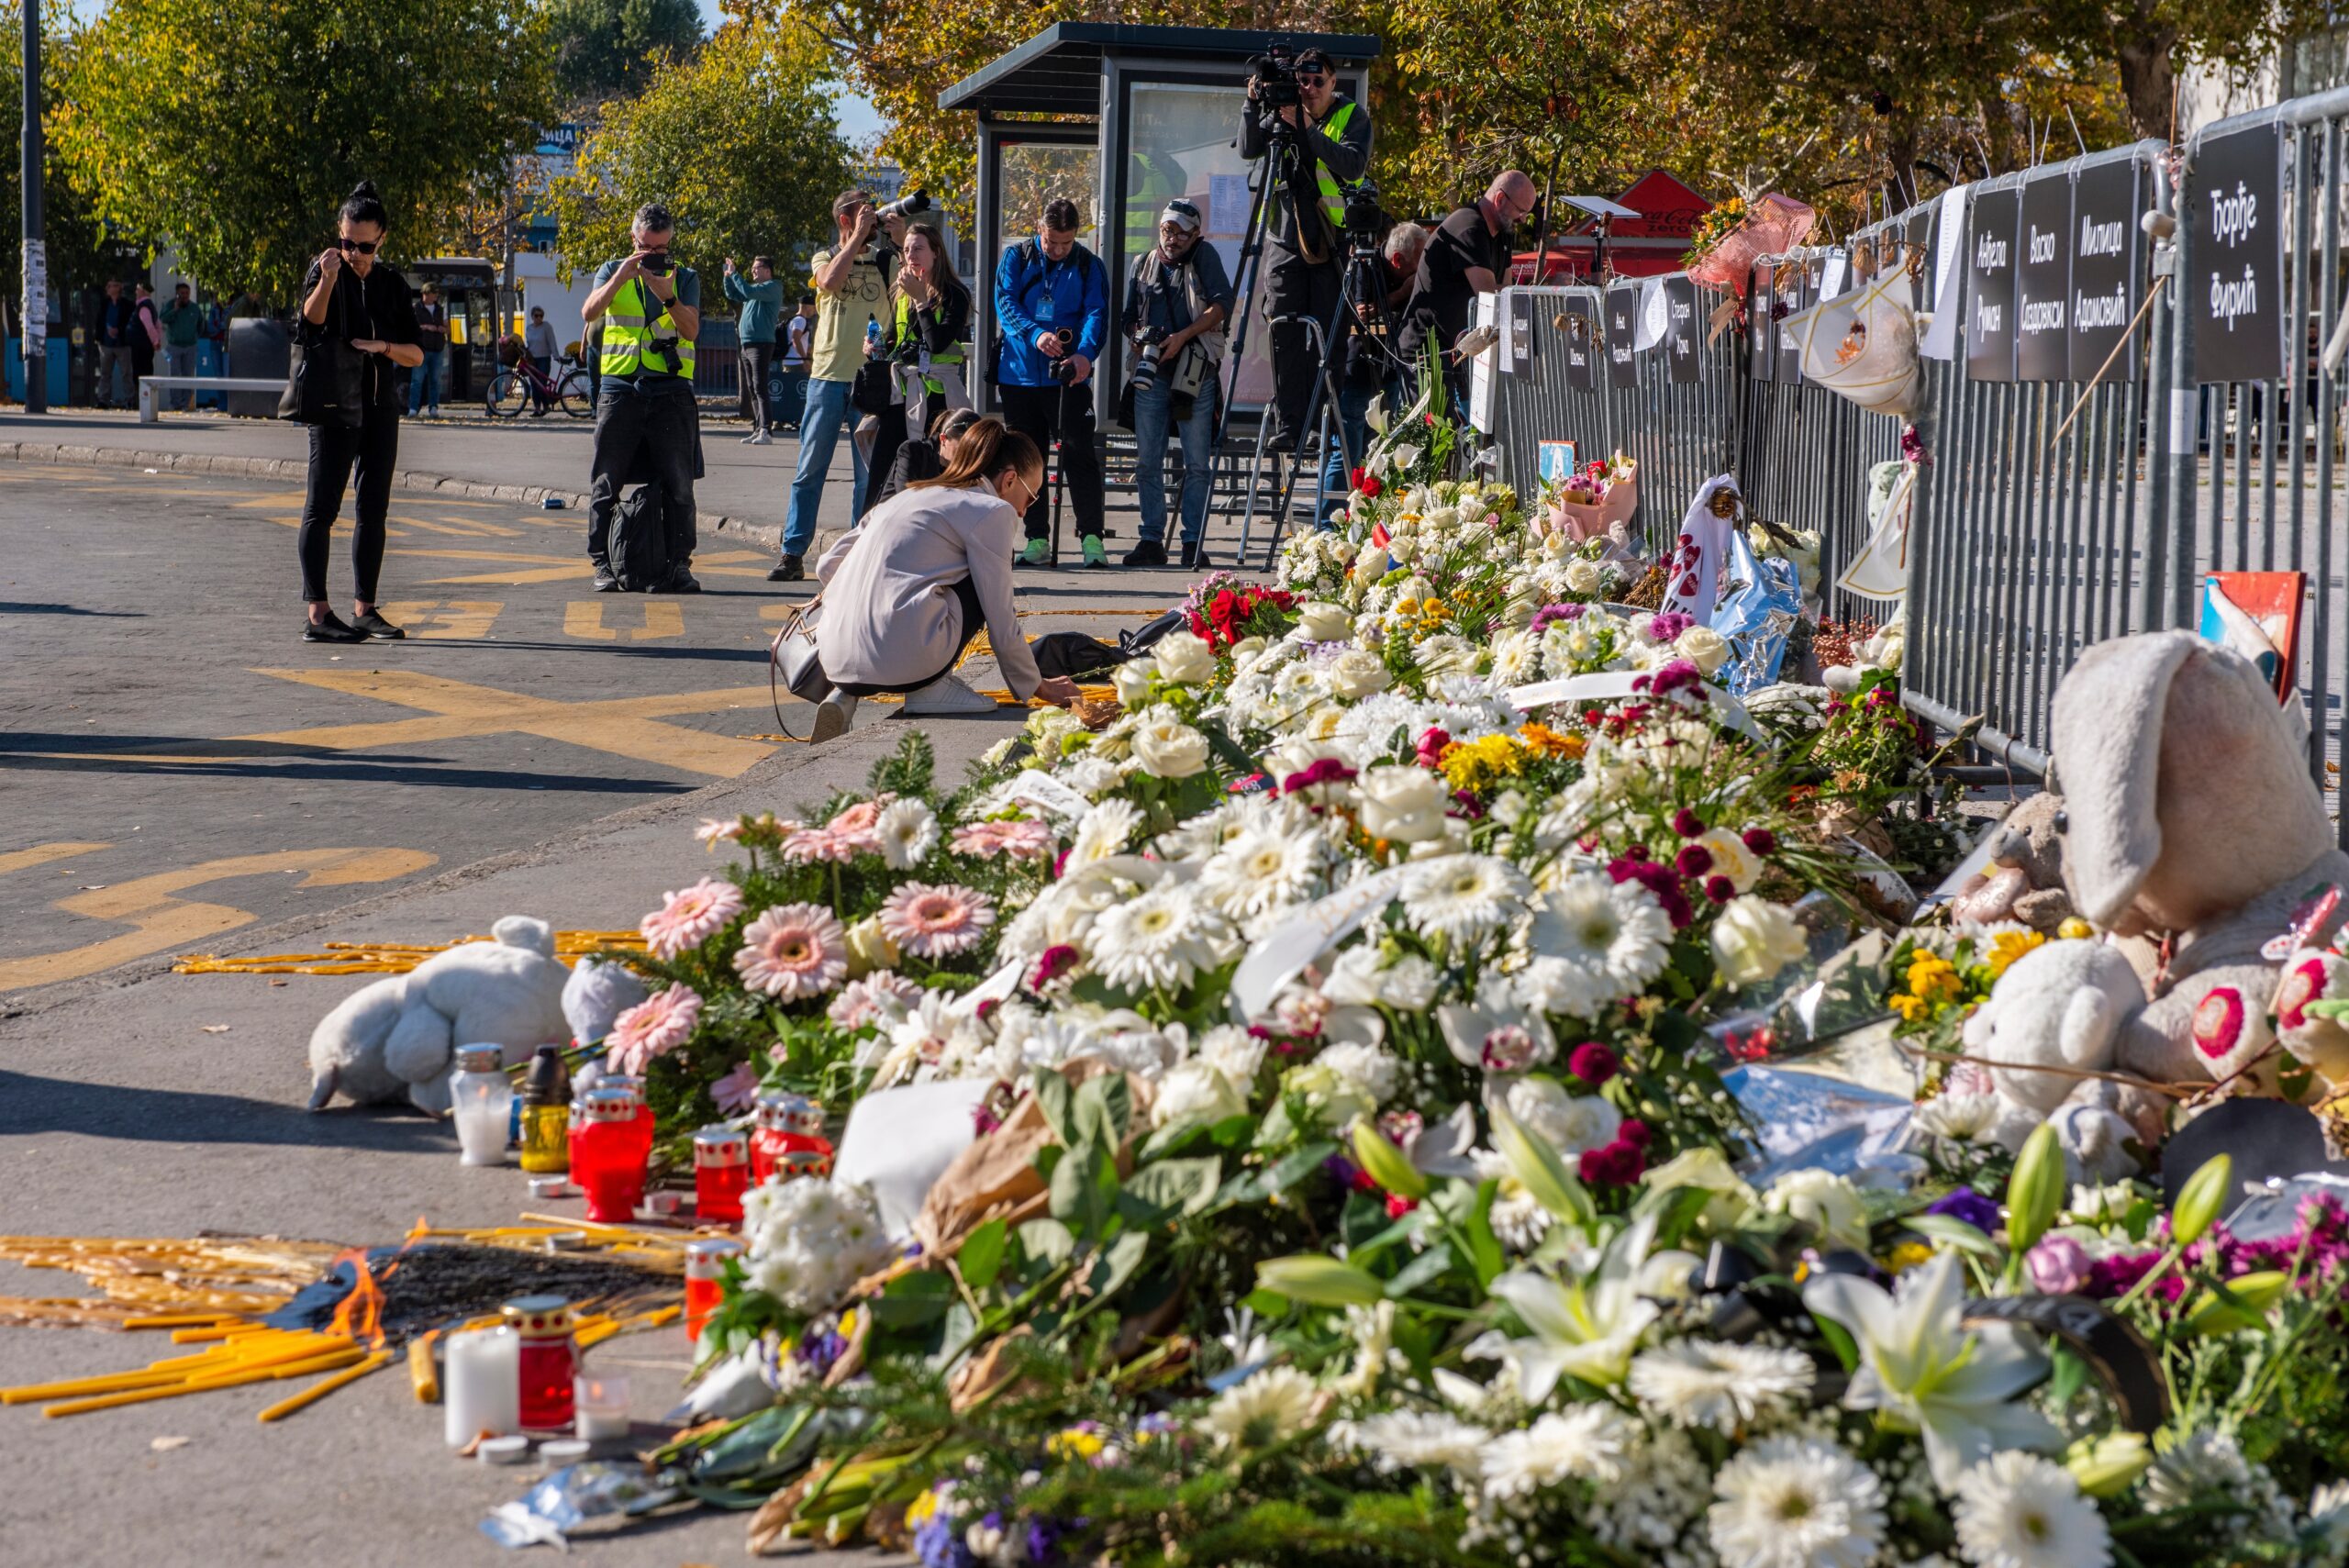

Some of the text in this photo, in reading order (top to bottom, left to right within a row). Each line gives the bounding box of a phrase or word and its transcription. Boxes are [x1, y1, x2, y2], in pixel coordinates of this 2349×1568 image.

[2080, 214, 2123, 258] Милица
[2210, 180, 2257, 249] Ђорђе
[1976, 229, 2007, 276] Анђела
[2030, 224, 2055, 264] Васко
[1671, 298, 1690, 326] Стефан
[1976, 294, 2001, 343] Руман
[2074, 281, 2125, 333] Адамовић
[2210, 263, 2257, 332] Фирић
